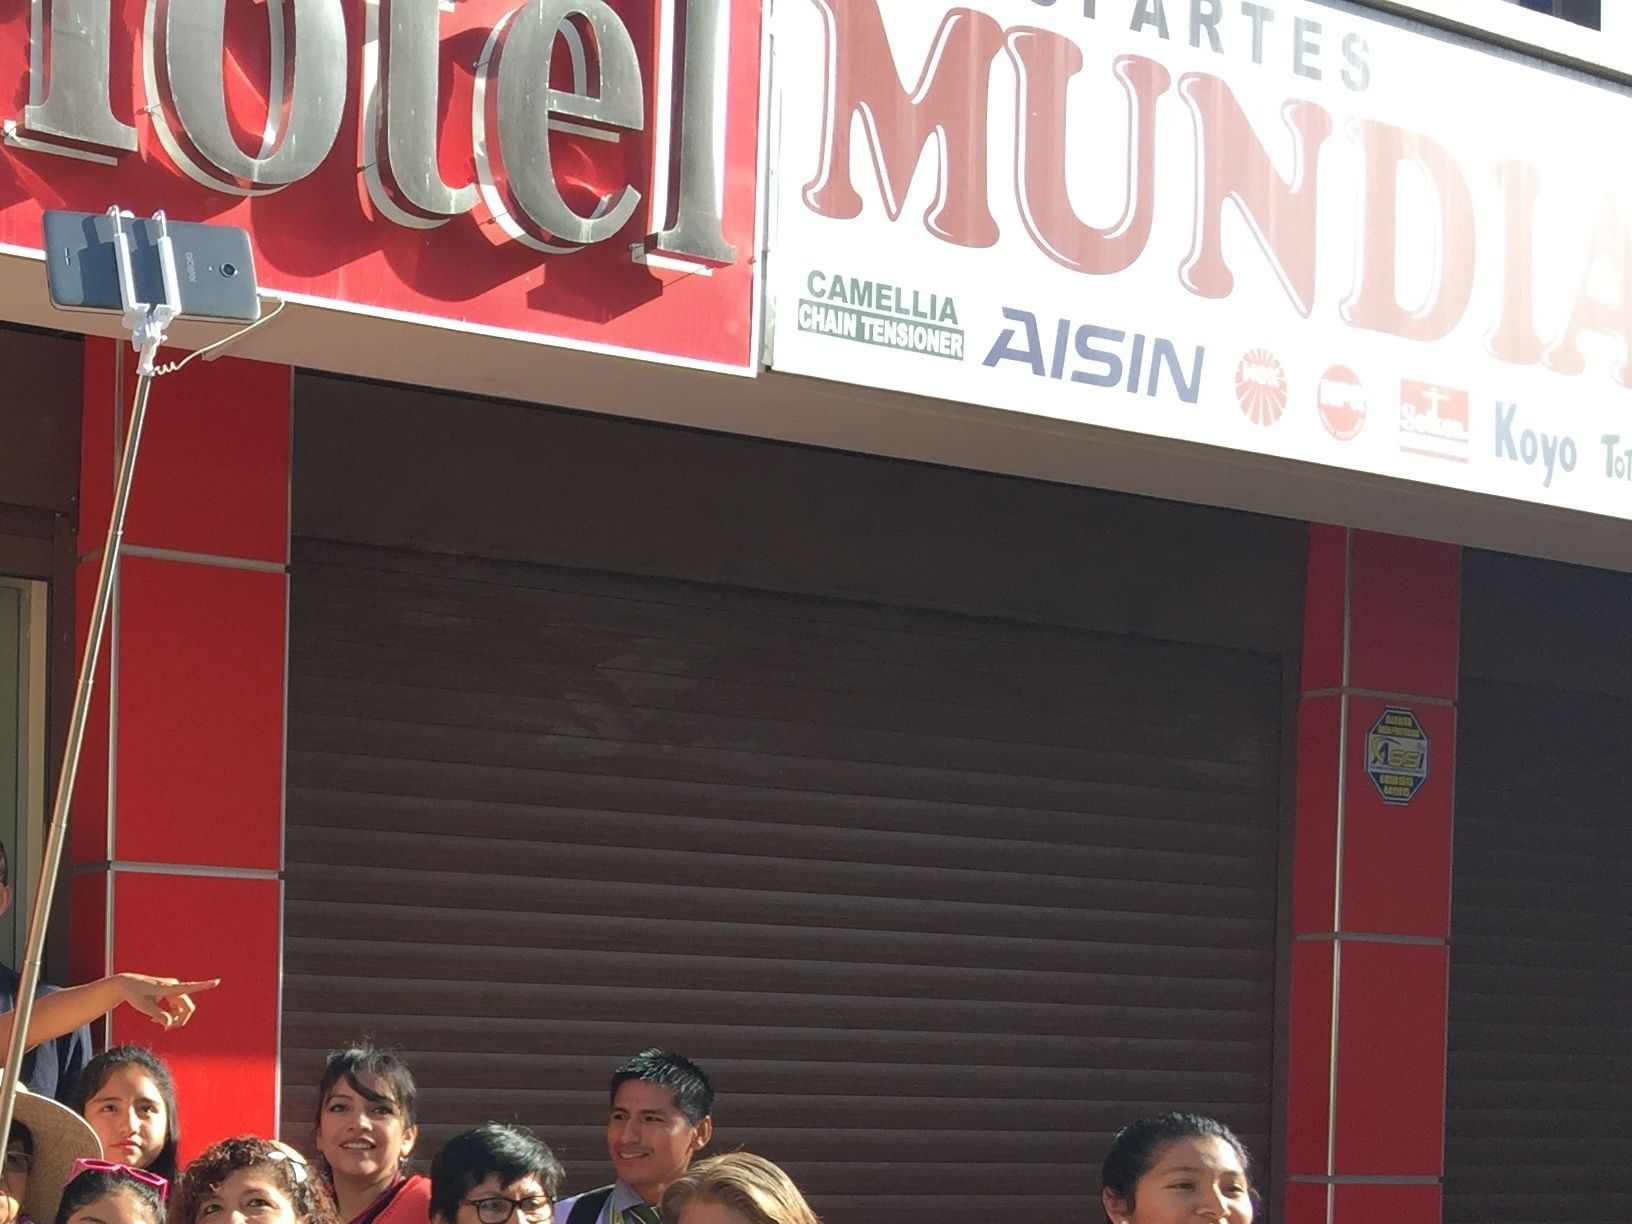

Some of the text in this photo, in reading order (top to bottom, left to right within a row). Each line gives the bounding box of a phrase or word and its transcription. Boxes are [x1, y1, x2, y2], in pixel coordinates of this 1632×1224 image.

[1029, 0, 1370, 92] ARTES
[801, 303, 964, 357] CHAIN TENSIONER
[806, 269, 959, 325] CAMELLIA
[983, 306, 1205, 404] AISIN
[1495, 400, 1577, 488] Koyo
